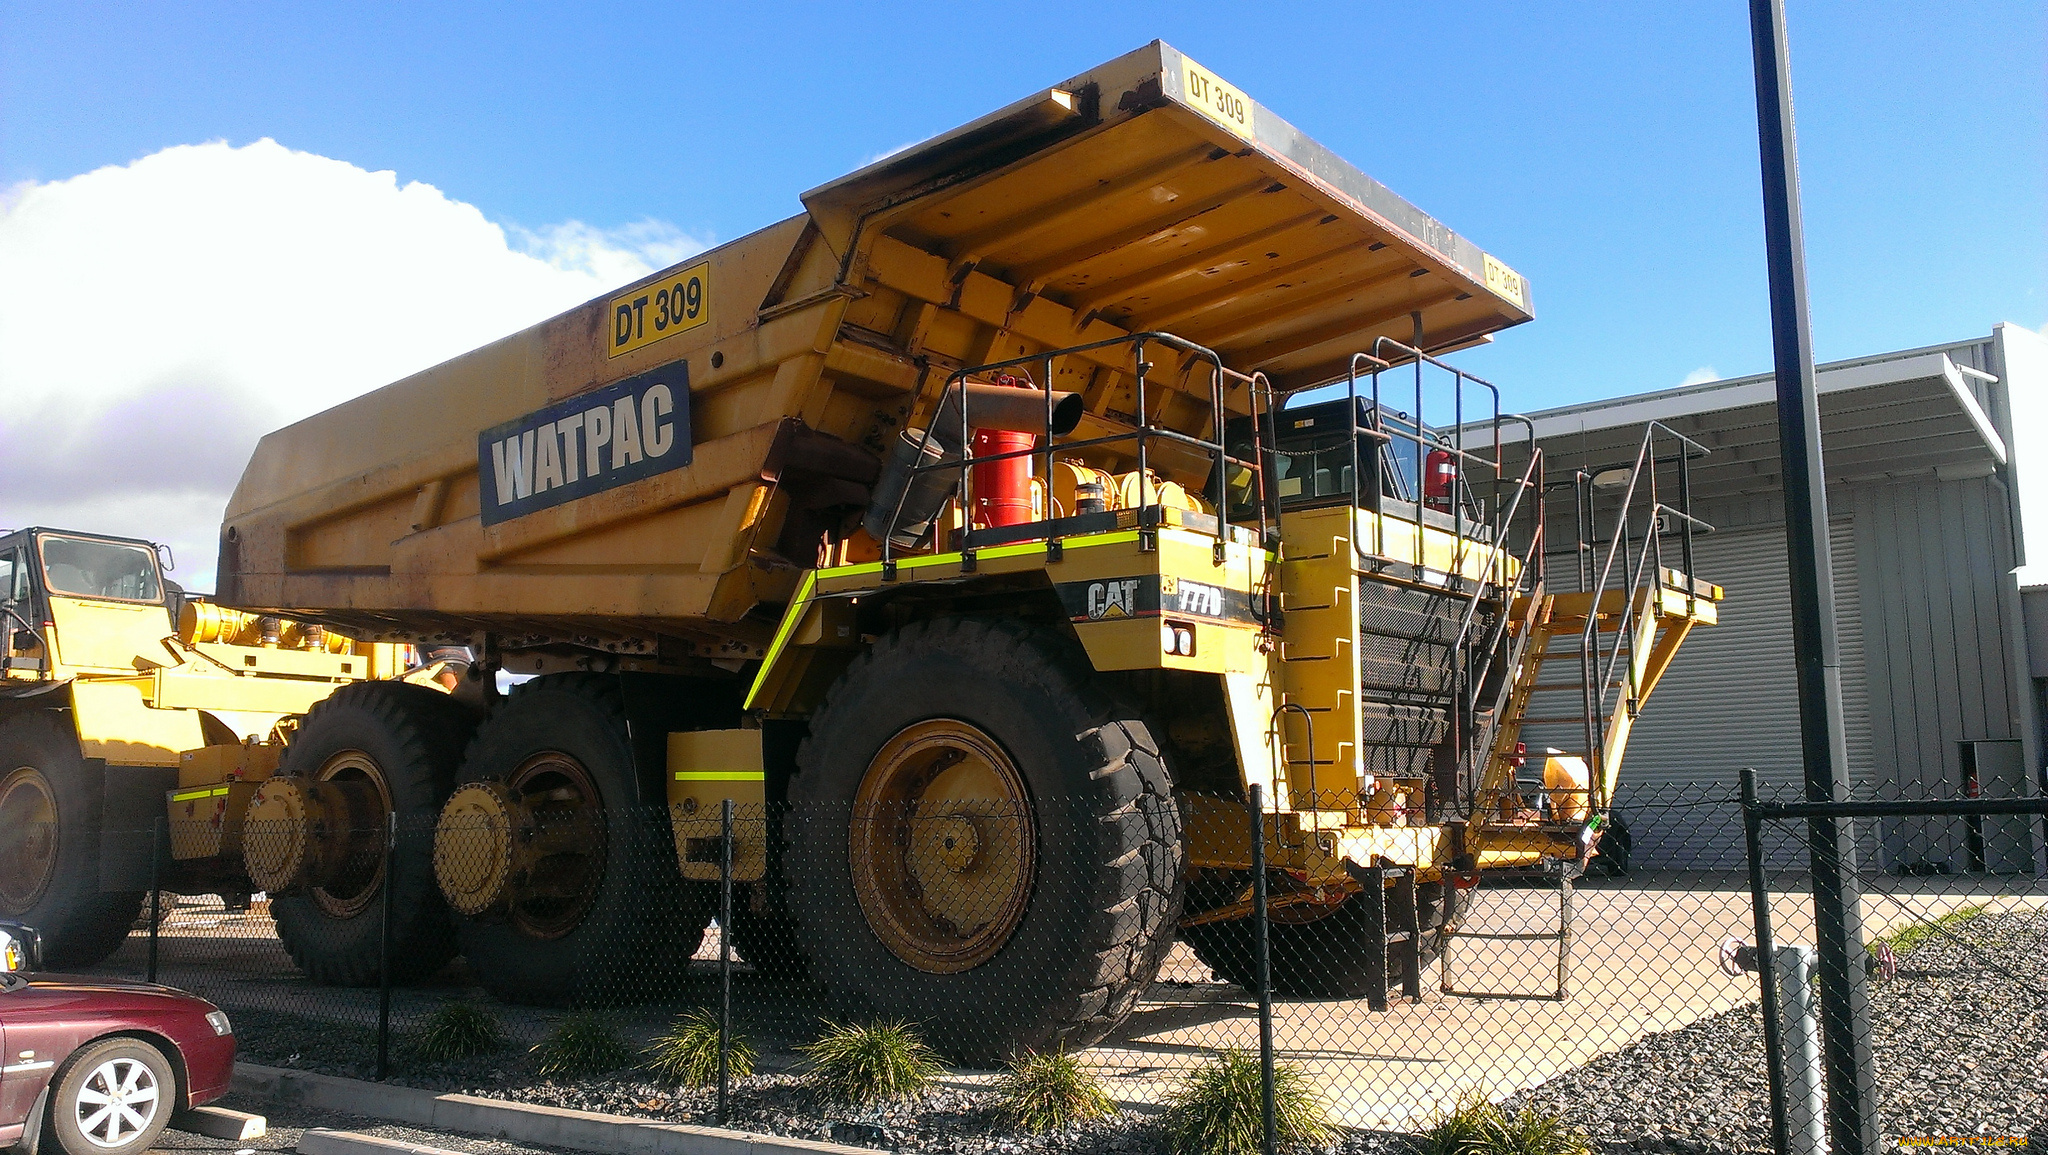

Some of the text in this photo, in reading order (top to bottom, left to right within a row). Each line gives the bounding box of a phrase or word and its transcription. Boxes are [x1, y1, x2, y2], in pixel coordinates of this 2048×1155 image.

[1190, 70, 1244, 124] DT 309
[1488, 262, 1518, 296] DT 309
[616, 277, 701, 347] DT 309
[492, 384, 674, 506] WATPAC
[1088, 579, 1138, 620] CAT
[1178, 581, 1222, 616] 777D
